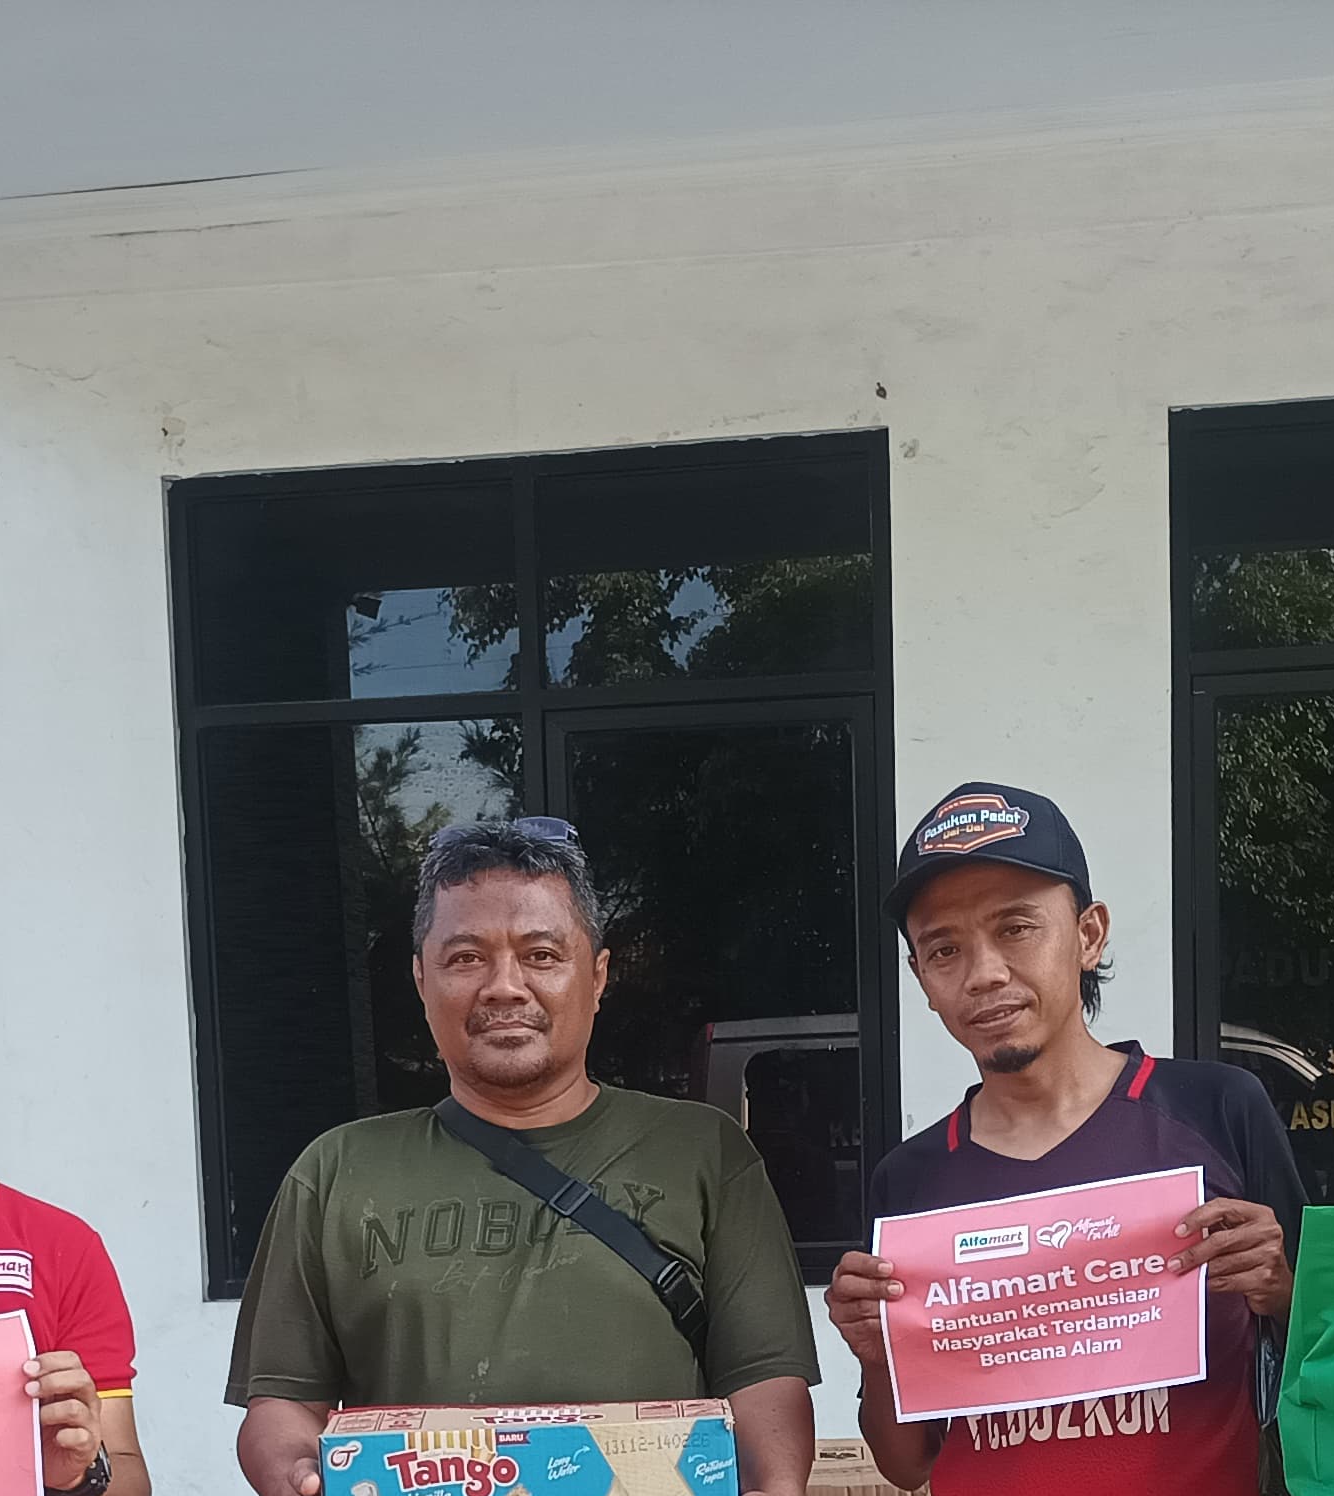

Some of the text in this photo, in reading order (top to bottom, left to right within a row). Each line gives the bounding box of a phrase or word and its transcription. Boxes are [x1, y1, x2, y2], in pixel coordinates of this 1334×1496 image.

[924, 813, 977, 842] Pasukan
[959, 1231, 1023, 1248] Alfamart
[924, 1253, 1166, 1308] Alfamart Care
[930, 1287, 1161, 1333] Bantuan Kemanusiaan
[931, 1305, 1163, 1353] Masyarakat Terdampak
[979, 1337, 1123, 1368] Bencana Alam
[498, 1433, 524, 1443] BARU
[547, 1456, 571, 1470] Long
